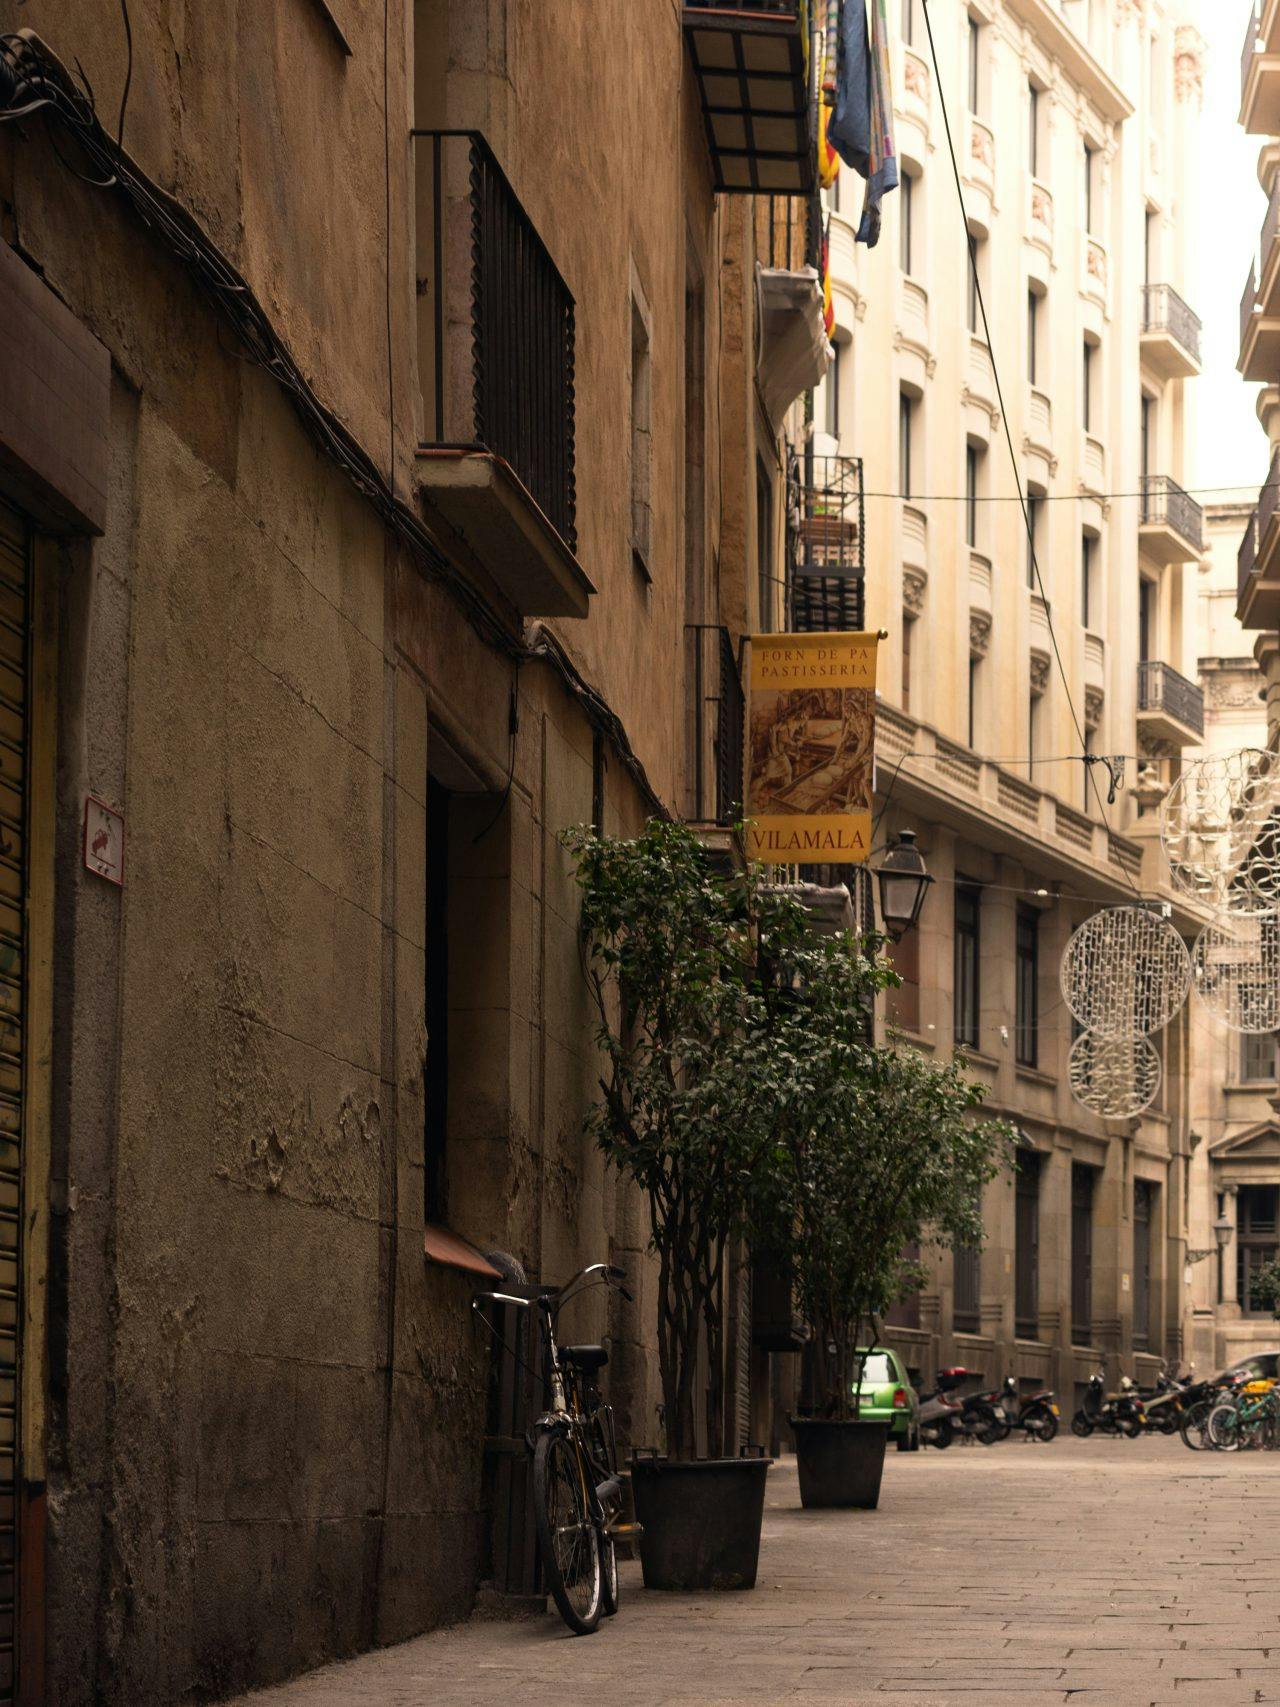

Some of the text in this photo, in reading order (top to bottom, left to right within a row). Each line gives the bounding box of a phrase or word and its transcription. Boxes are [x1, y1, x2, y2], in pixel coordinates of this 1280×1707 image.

[762, 647, 868, 660] FORN DE PA
[762, 664, 867, 677] PASTISSERIA
[752, 829, 864, 849] VILAMALA
